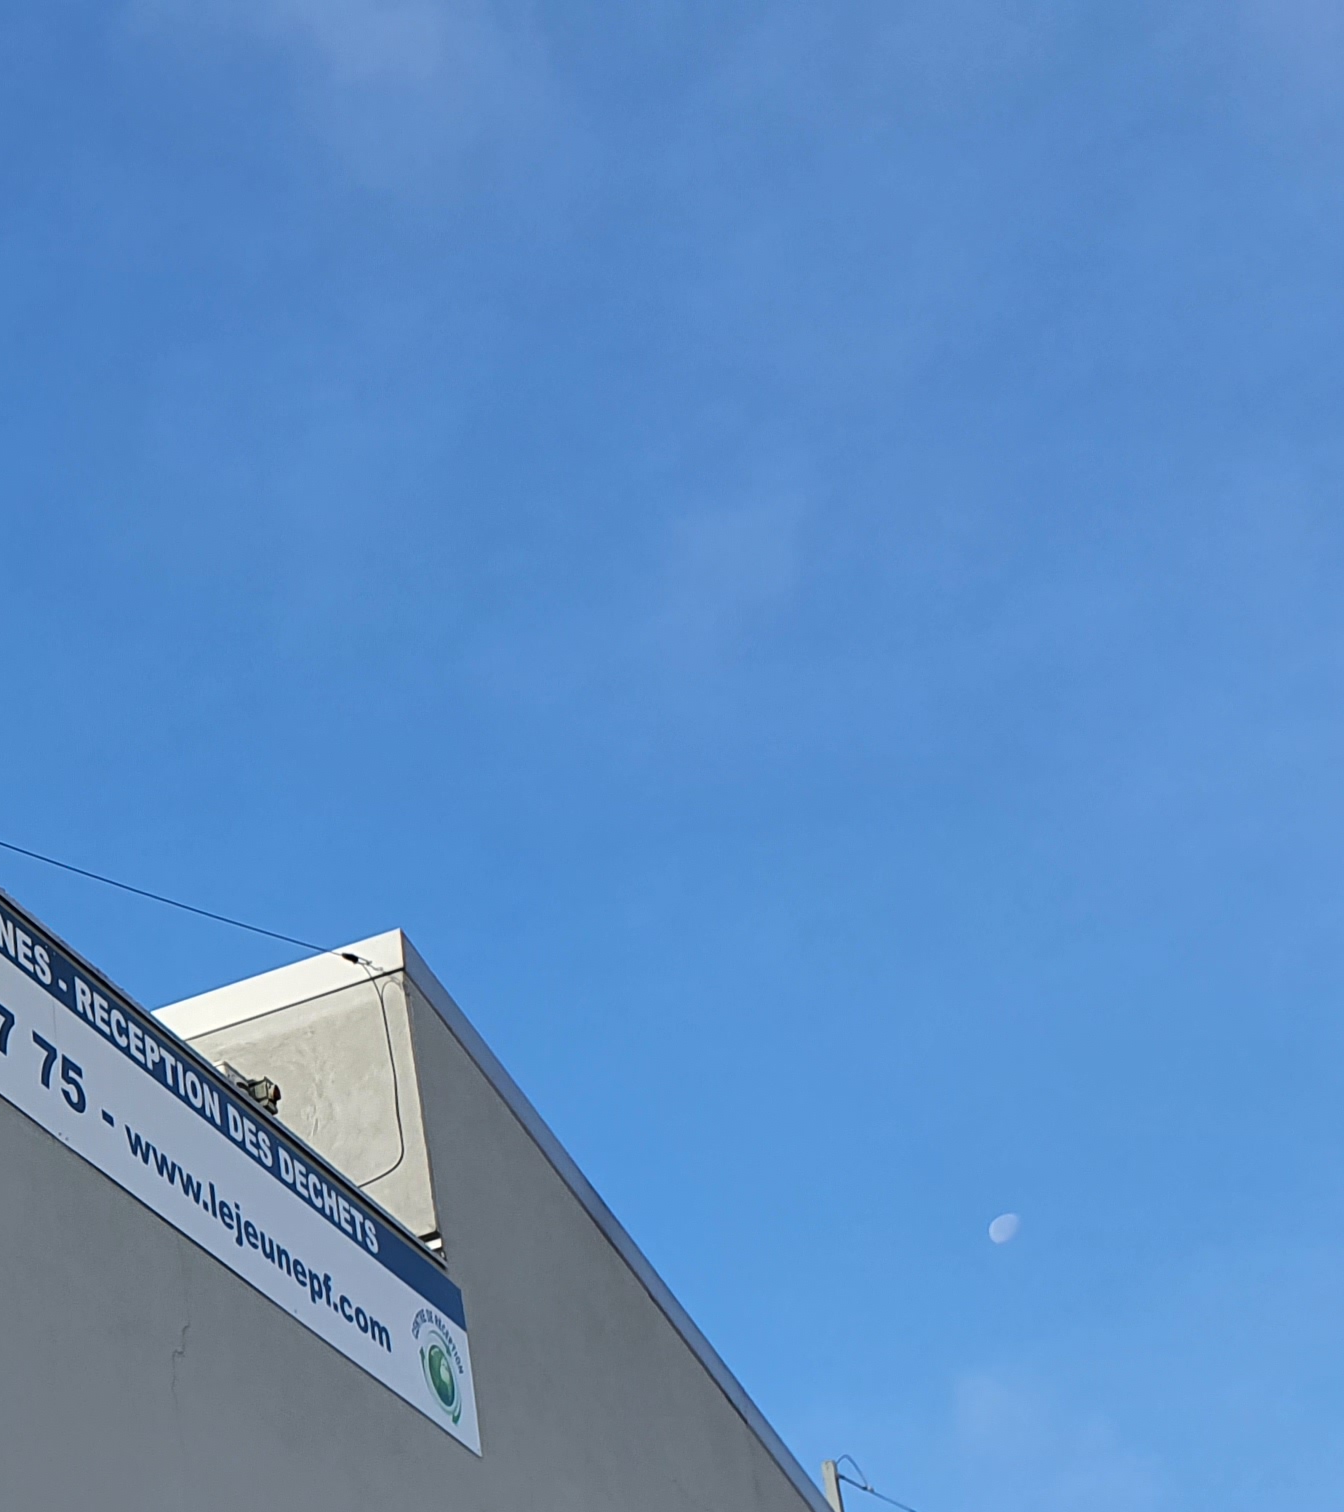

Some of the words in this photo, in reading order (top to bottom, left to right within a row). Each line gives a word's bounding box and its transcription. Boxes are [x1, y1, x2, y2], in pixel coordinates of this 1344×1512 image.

[32, 1030, 88, 1114] 75
[125, 1123, 392, 1353] www.lejeunepf.com
[74, 976, 221, 1126] RECEPTION
[227, 1102, 274, 1168] DES
[278, 1150, 380, 1254] DECHETS
